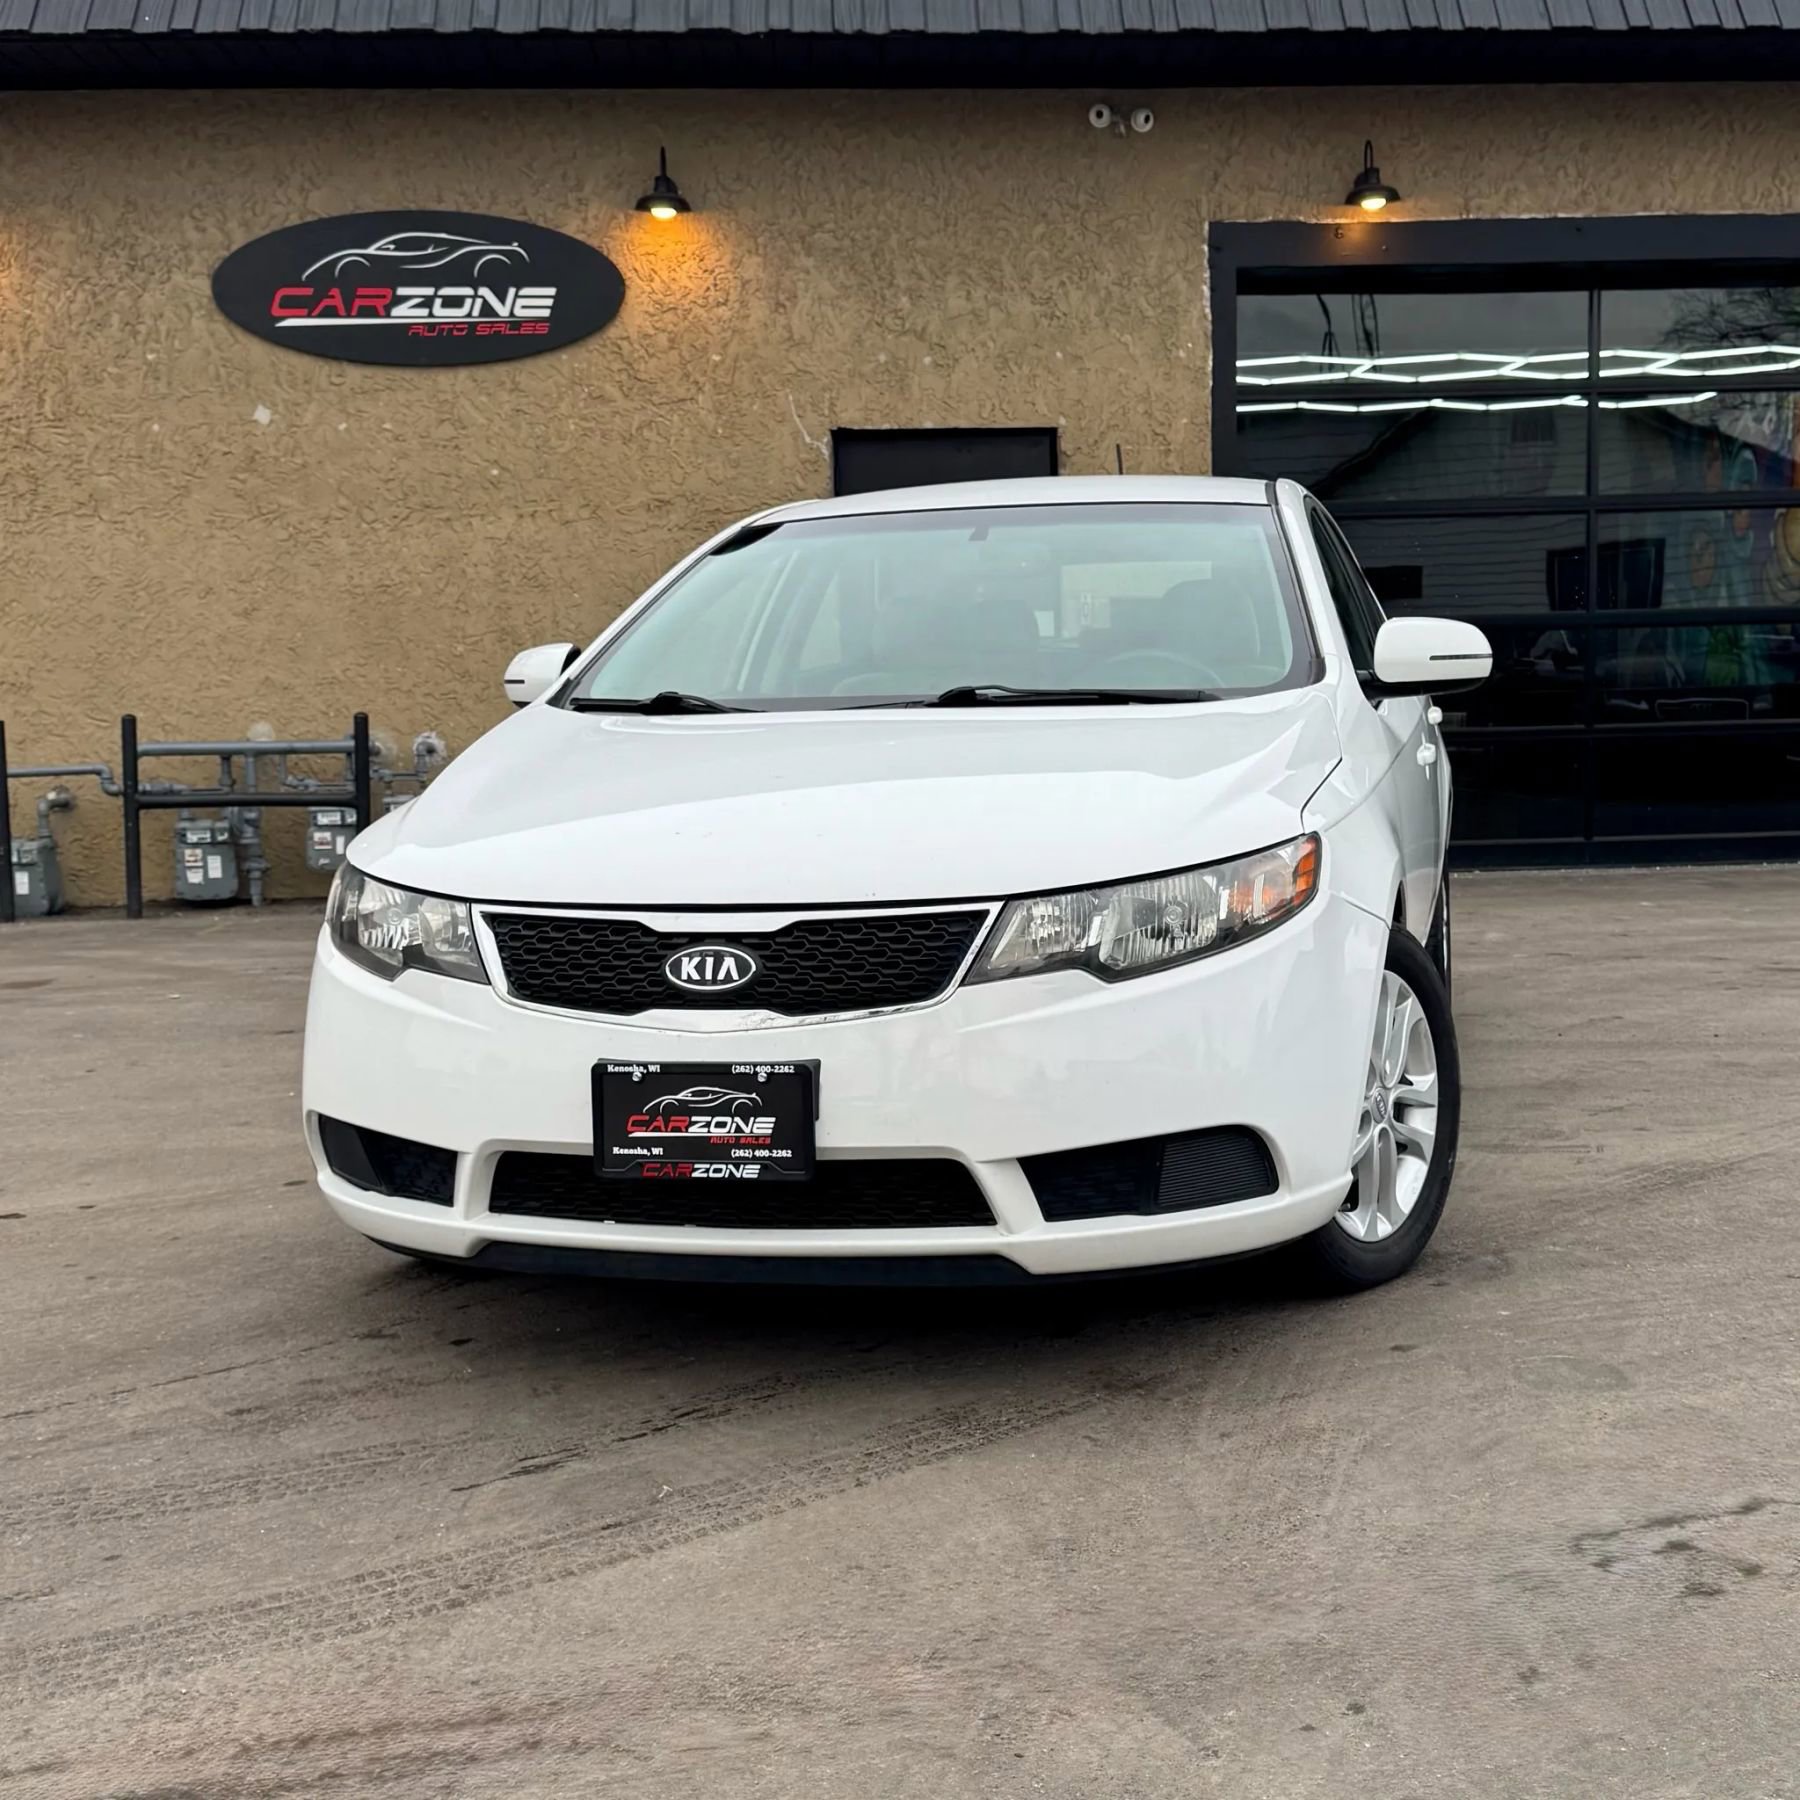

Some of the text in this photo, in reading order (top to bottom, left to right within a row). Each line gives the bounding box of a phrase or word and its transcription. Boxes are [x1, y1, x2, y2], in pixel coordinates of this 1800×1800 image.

[270, 286, 557, 318] CARZONE
[408, 322, 550, 337] AUTO SALES
[681, 957, 740, 980] KIA
[607, 1064, 661, 1074] Kenosha, WI
[731, 1064, 796, 1075] (262) 400-2262
[626, 1115, 777, 1134] CARZONE
[709, 1136, 772, 1145] AUTO SALES
[612, 1146, 664, 1157] Kenosha, WI
[731, 1148, 753, 1159] (262)
[641, 1163, 761, 1179] CARZONE
